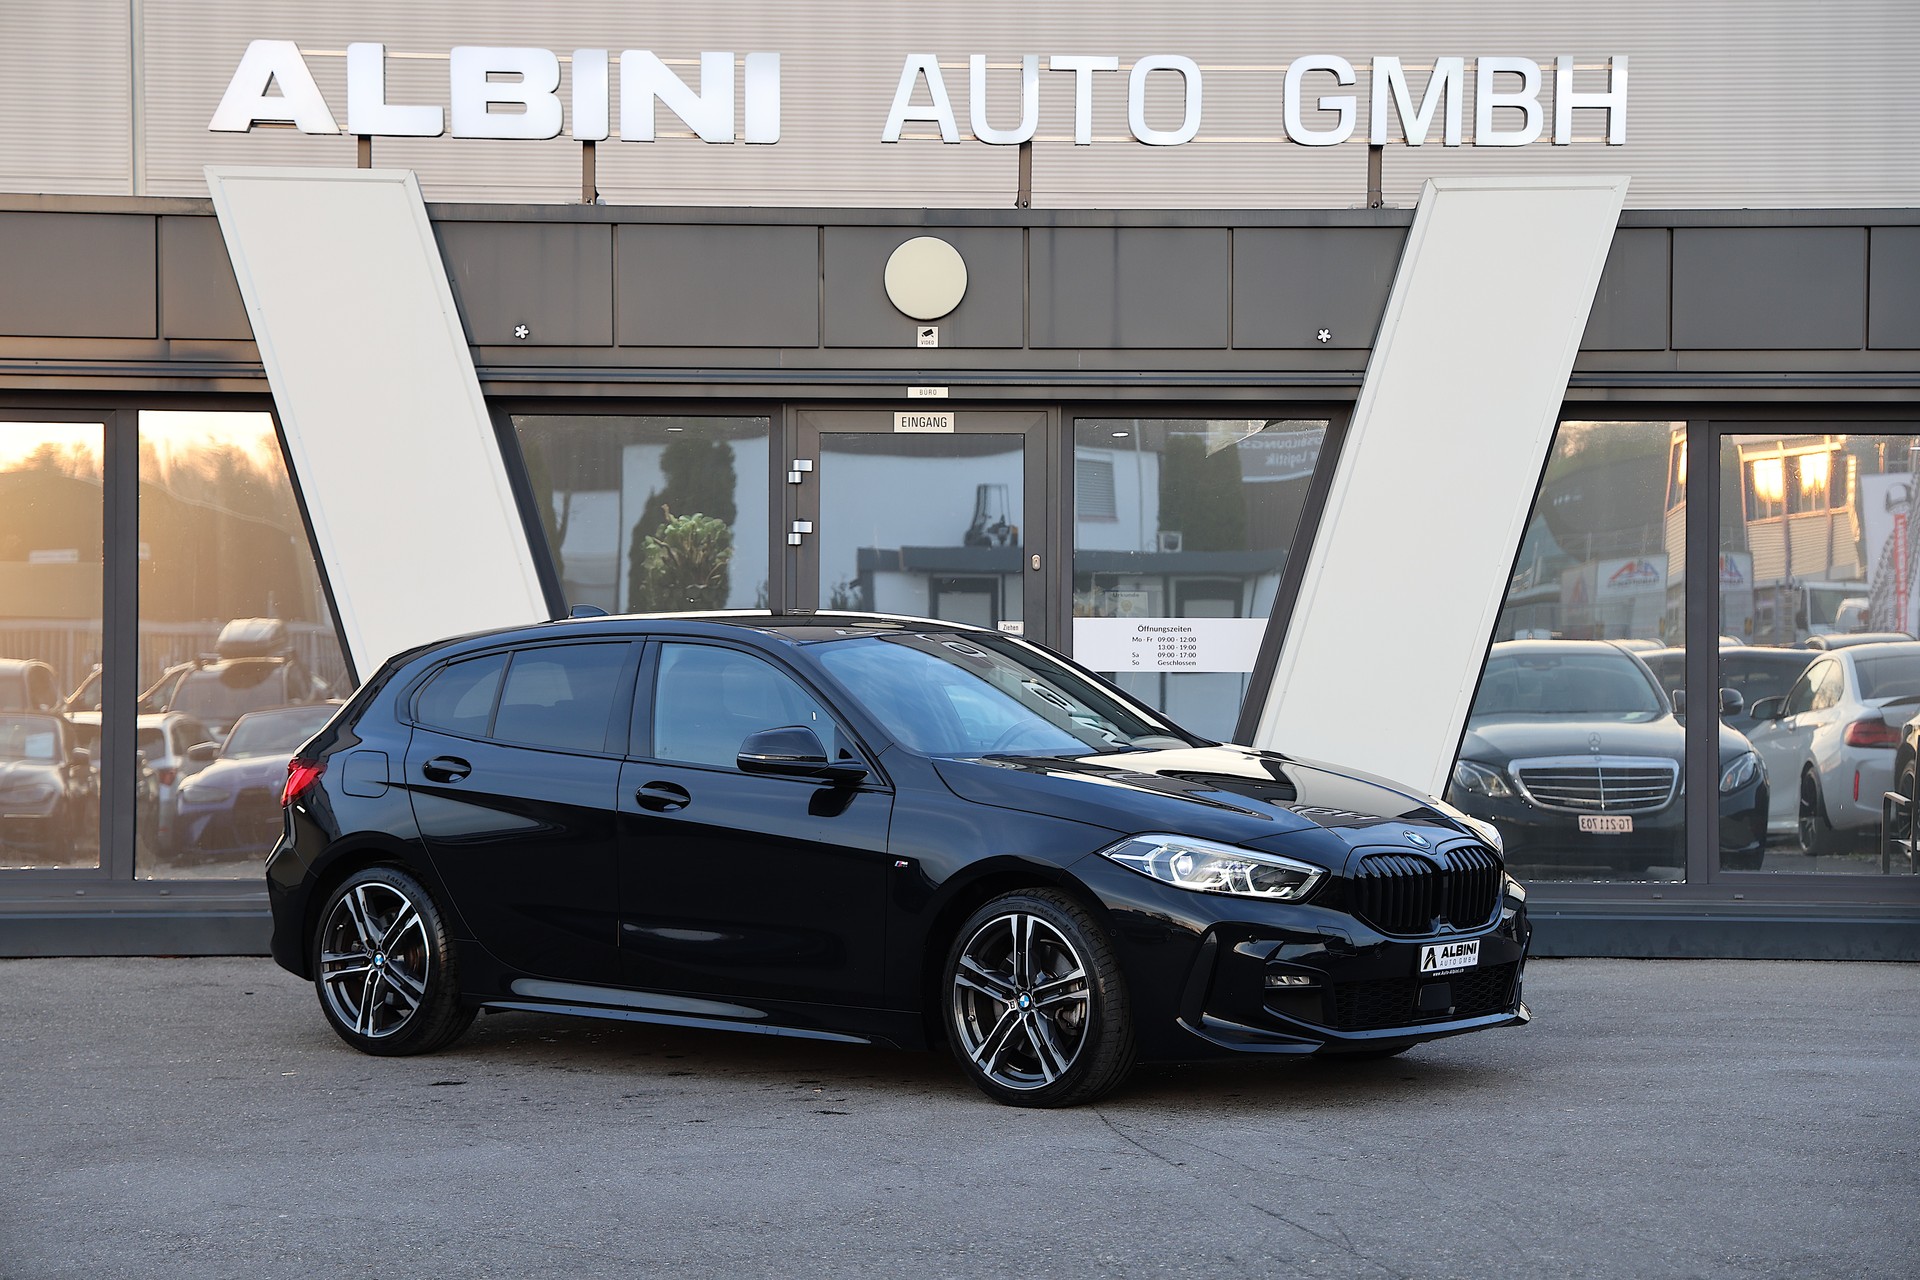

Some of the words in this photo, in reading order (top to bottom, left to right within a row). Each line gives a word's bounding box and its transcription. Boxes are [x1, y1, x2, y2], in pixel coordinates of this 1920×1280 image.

[208, 39, 781, 145] ALBINI
[881, 54, 1202, 147] AUTO
[1283, 54, 1628, 147] GMBH
[919, 388, 938, 396] BÜRO
[901, 416, 948, 428] EINGANG
[1137, 624, 1192, 634] Öffnungszeiten
[1441, 942, 1477, 958] ALBINI
[1440, 958, 1457, 967] AUTO
